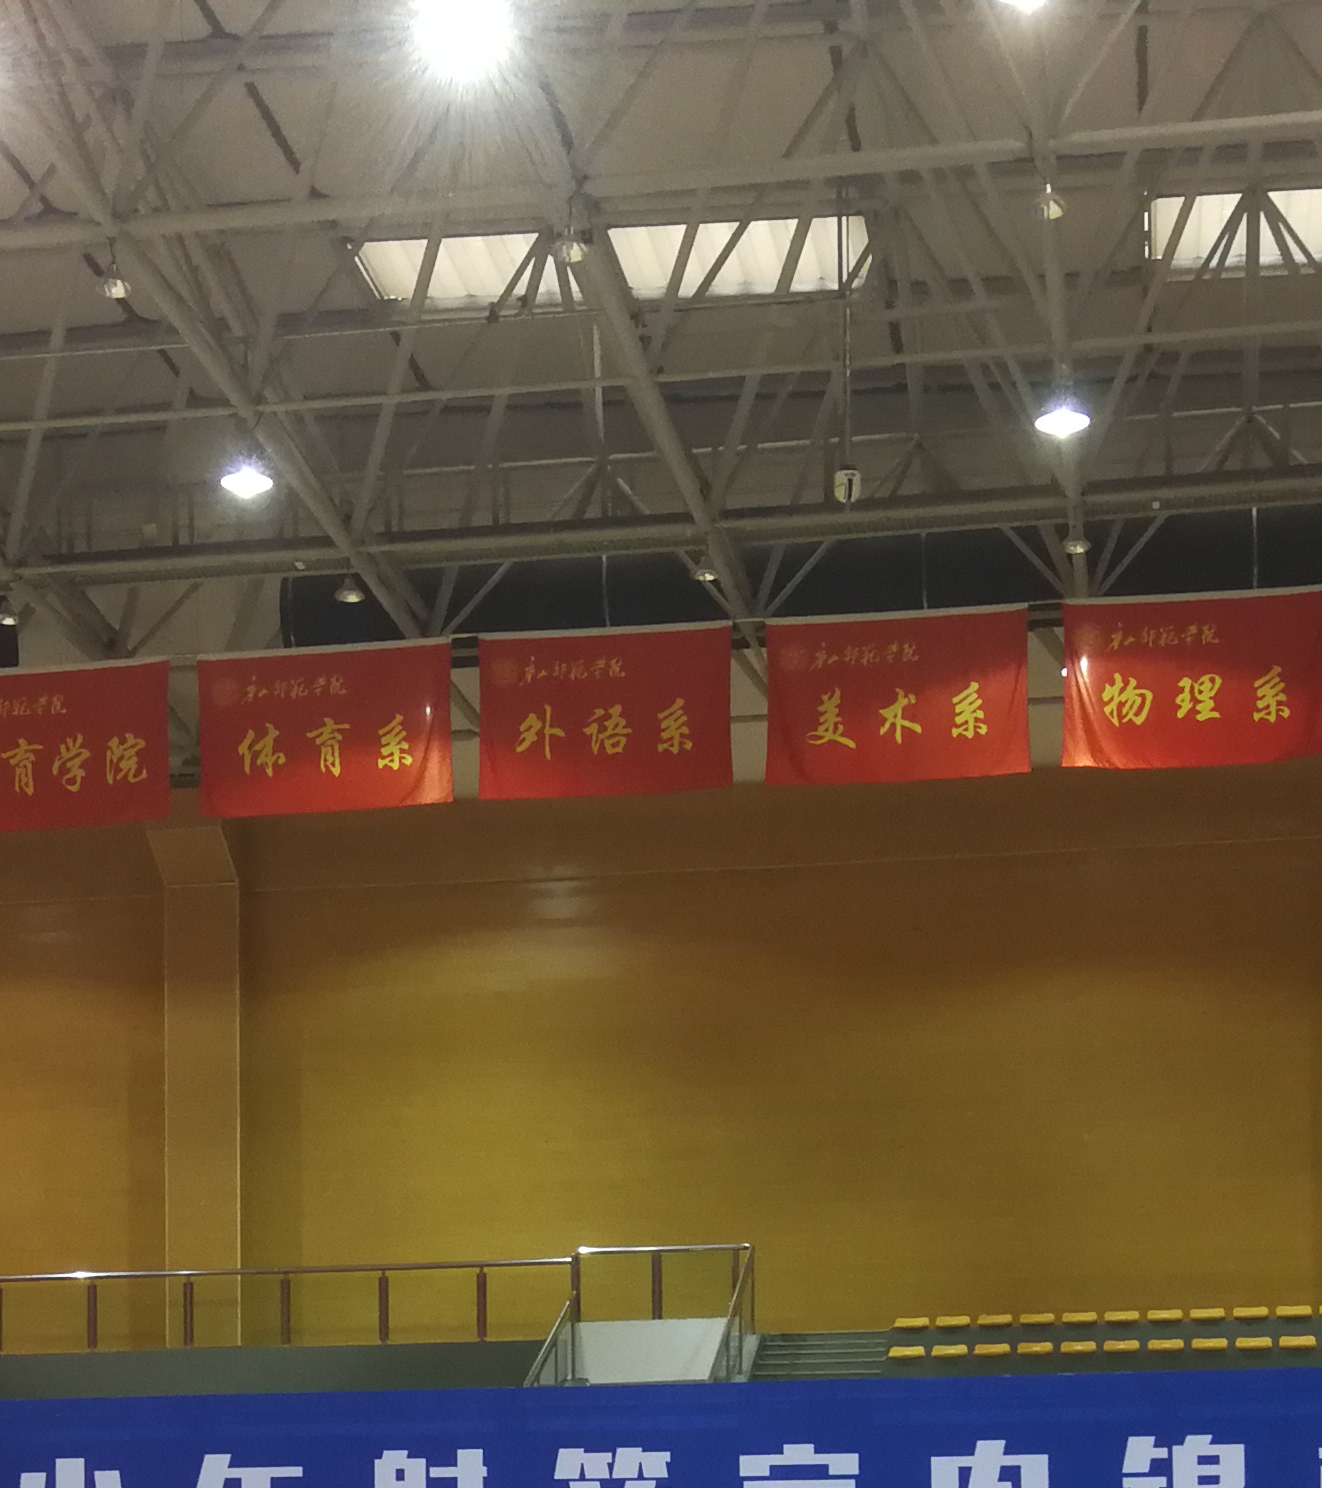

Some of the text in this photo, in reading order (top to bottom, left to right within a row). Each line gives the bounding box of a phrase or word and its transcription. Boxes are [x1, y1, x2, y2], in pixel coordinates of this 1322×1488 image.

[516, 698, 694, 761] 外语系
[807, 681, 989, 749] 美术系
[1102, 665, 1292, 730] 物理系
[237, 711, 415, 778] 体育系
